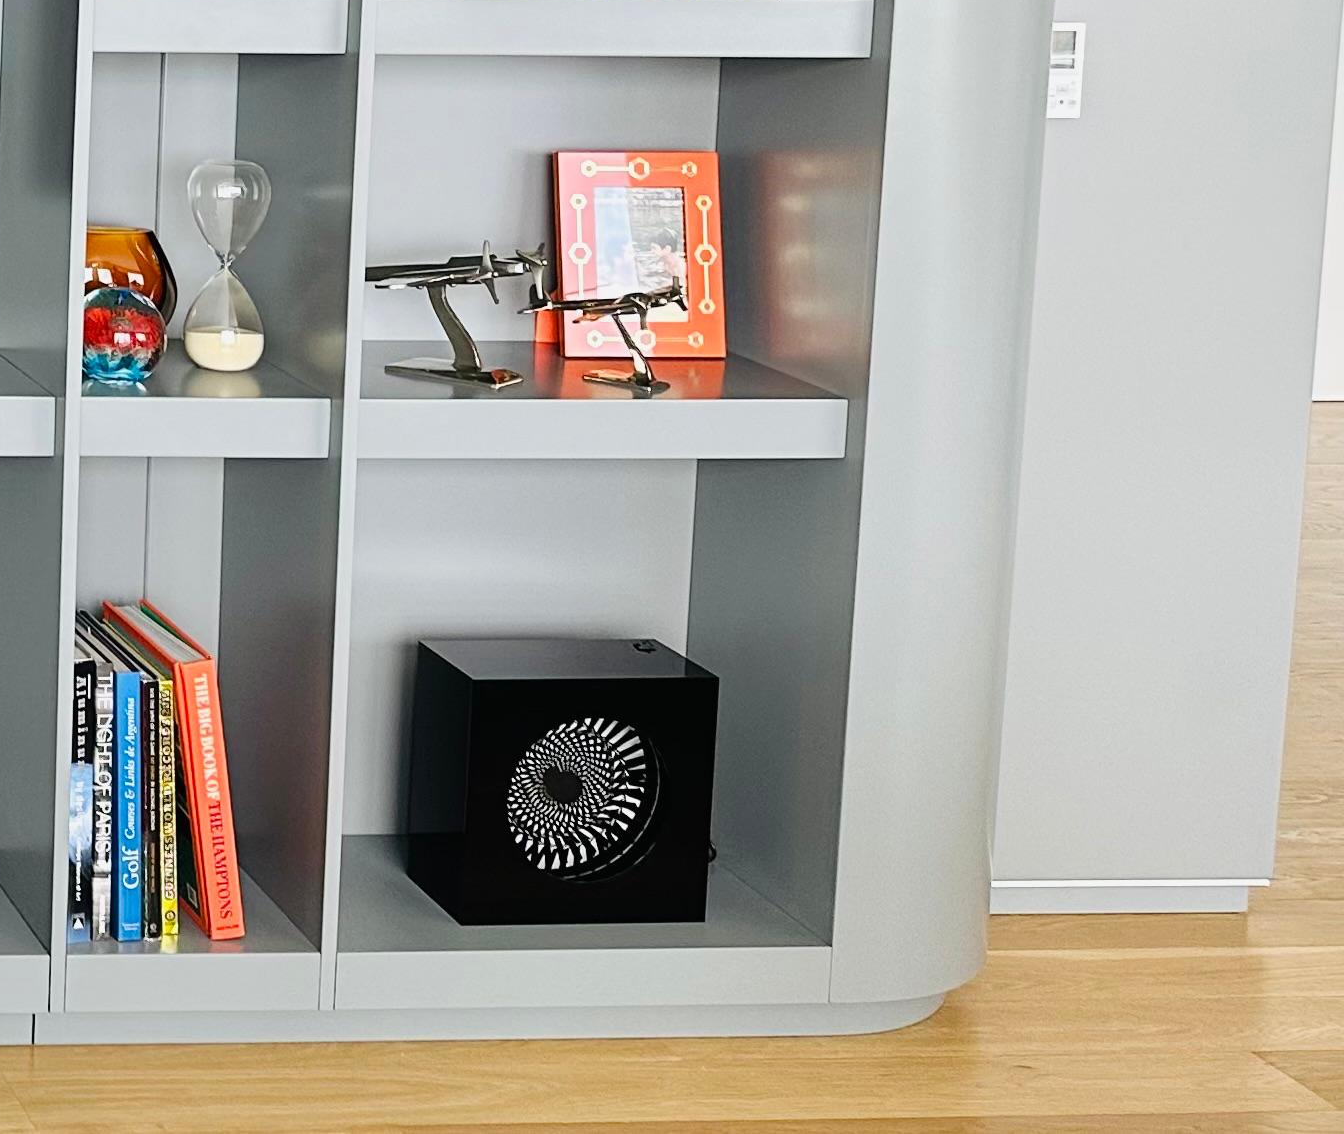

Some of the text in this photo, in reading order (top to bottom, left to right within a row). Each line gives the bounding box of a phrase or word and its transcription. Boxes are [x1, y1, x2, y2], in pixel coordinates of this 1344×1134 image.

[96, 672, 114, 711] THE
[194, 674, 210, 708] THE
[197, 708, 213, 737] BIG
[200, 737, 218, 780] BOOK
[123, 697, 139, 890] Golf Courses & Links de Argentina
[162, 785, 175, 835] WORLD
[205, 780, 221, 800] OF
[209, 801, 223, 836] THE
[163, 836, 176, 900] GUINNESS
[211, 837, 233, 920] HAMPTONS
